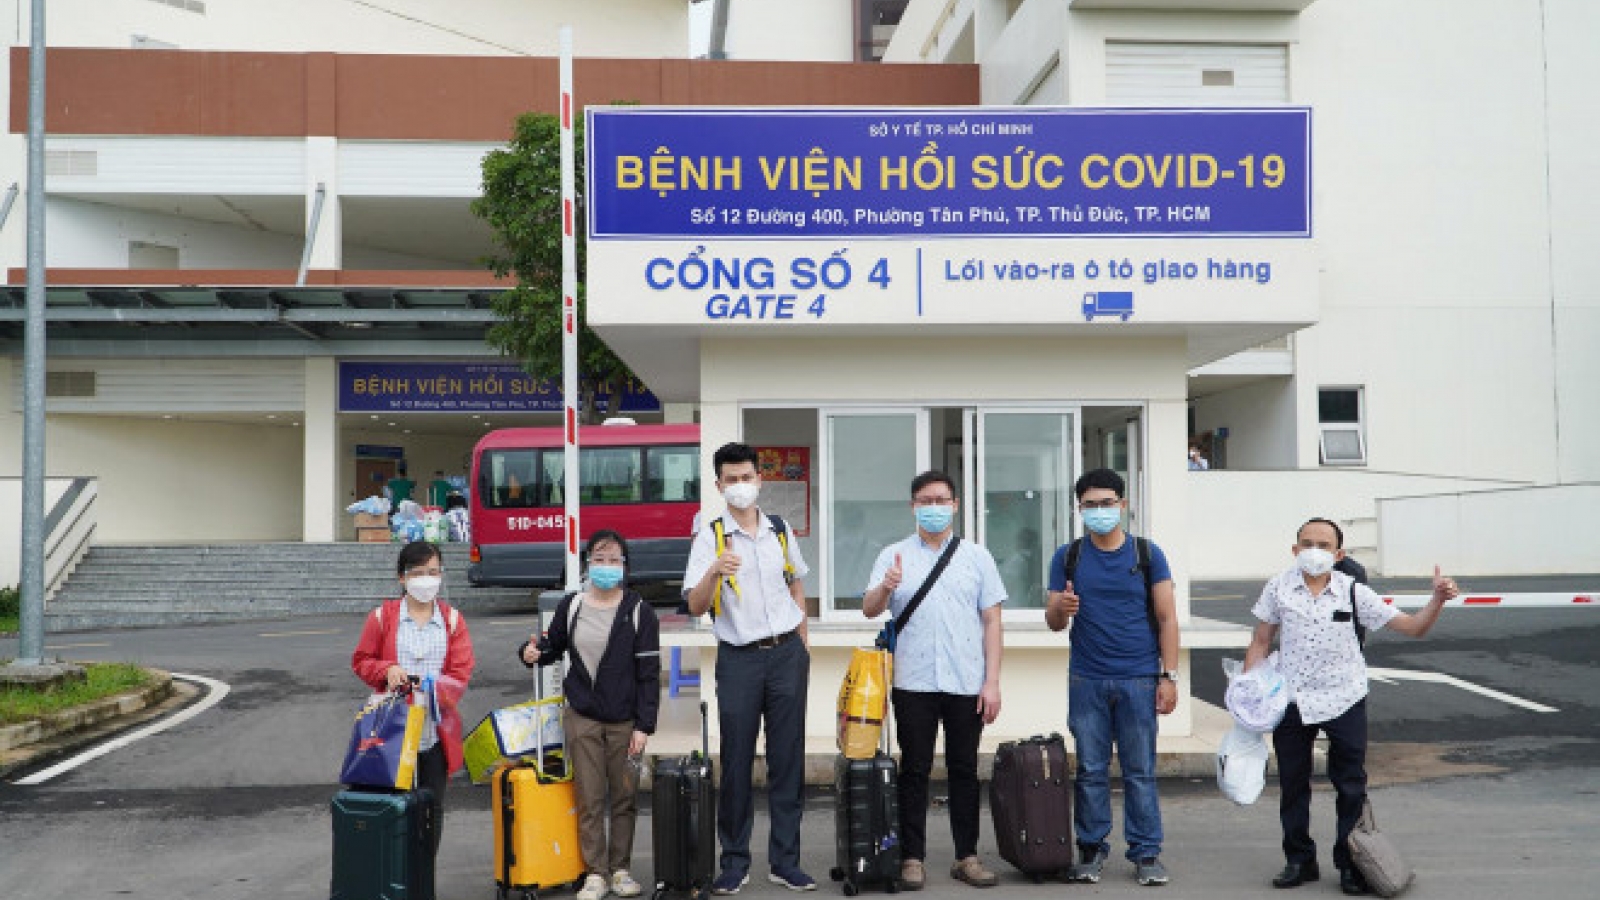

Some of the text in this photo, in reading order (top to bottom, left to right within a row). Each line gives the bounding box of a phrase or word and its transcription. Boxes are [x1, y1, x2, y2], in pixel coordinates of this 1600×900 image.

[891, 123, 900, 137] Y
[904, 120, 922, 137] TẾ
[971, 121, 995, 135] CHÍ
[998, 123, 1034, 135] MINH
[616, 141, 1286, 198] BỆNH VIỆN HỒI SỨC COVID-19
[690, 206, 716, 225] Số
[720, 208, 741, 225] 12
[746, 206, 806, 227] Đường
[811, 208, 849, 227] 400,
[854, 206, 925, 228] Phường
[928, 206, 964, 223] Tân
[1015, 206, 1043, 223] TP.
[1048, 204, 1084, 223] Thủ
[1087, 205, 1129, 225] Đức,
[1134, 206, 1162, 222] TP.
[1166, 206, 1212, 222] HCM
[644, 245, 892, 291] CỔNG SỐ 4
[944, 257, 984, 281] Lối
[993, 259, 1076, 281] vào-ra
[1108, 257, 1134, 280] tô
[1142, 258, 1199, 284] giao
[1206, 257, 1272, 284] hàng
[705, 293, 827, 320] GATE 4
[353, 373, 411, 397] BỆNH
[416, 373, 462, 397] VIỆN
